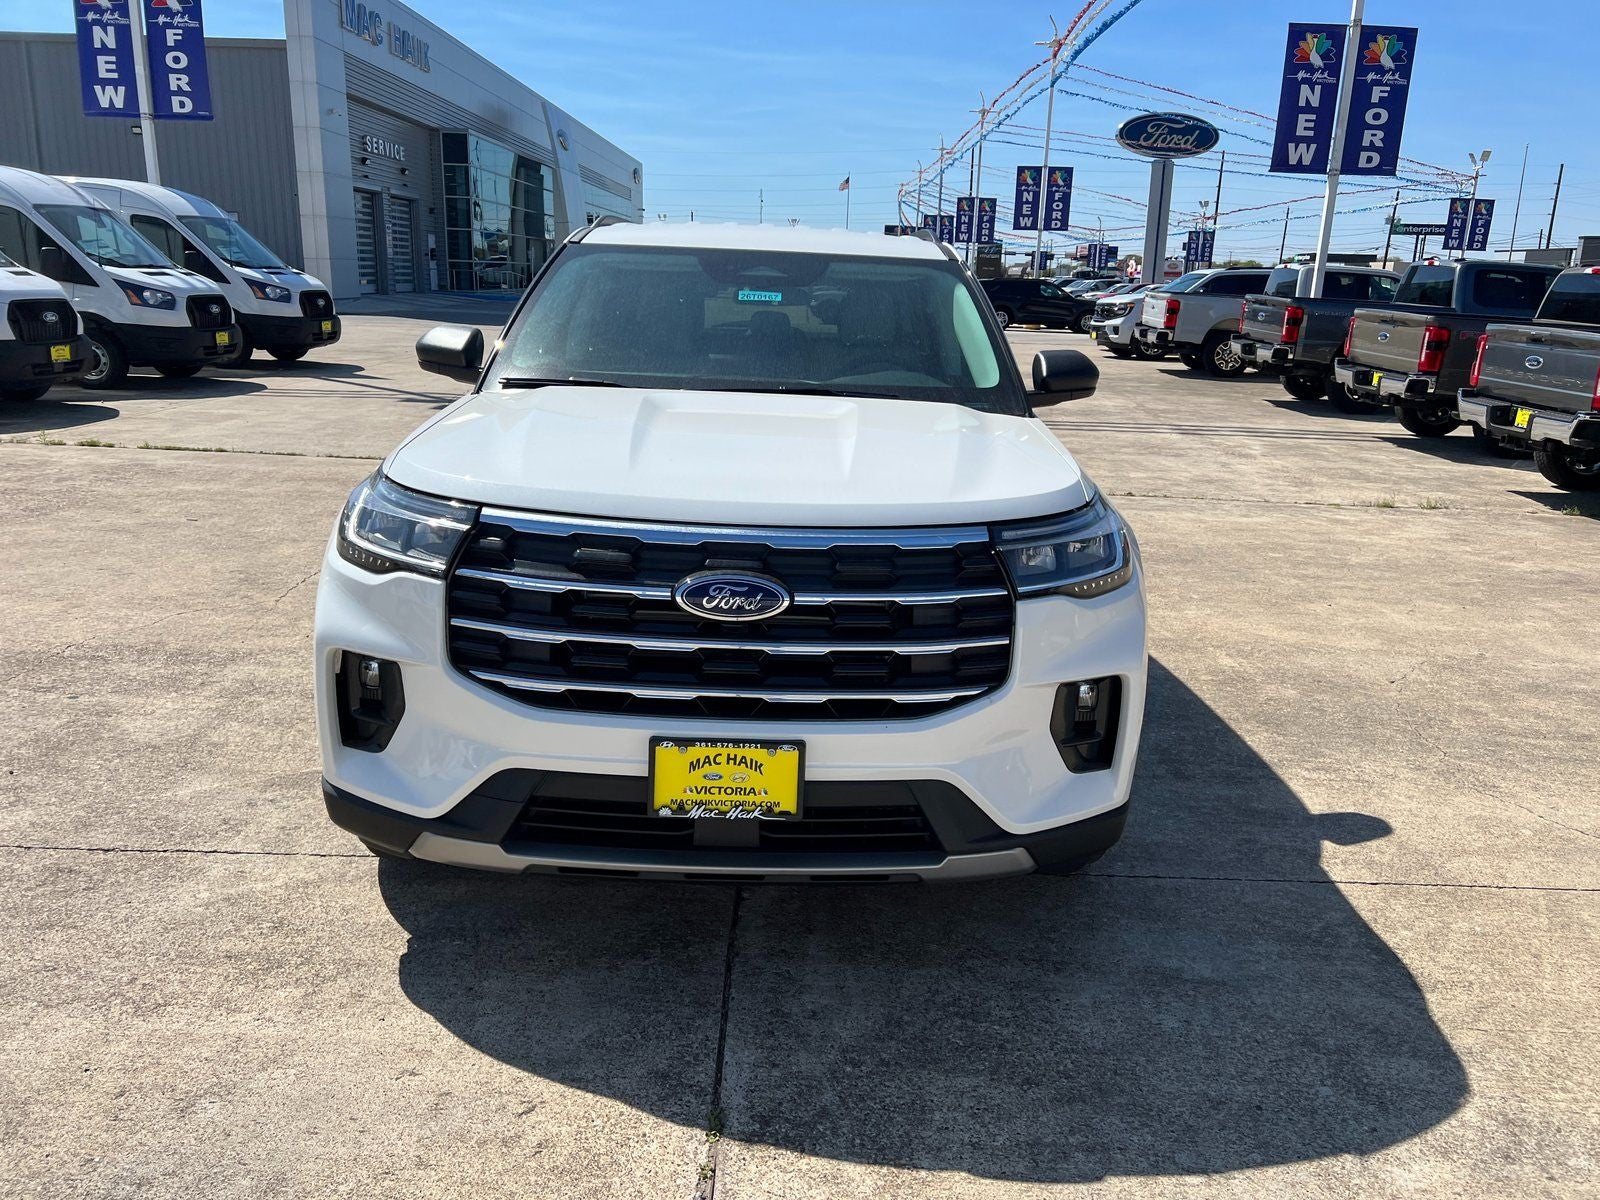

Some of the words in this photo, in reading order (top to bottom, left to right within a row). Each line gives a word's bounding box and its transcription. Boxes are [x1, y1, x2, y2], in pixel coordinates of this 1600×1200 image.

[339, 0, 384, 47] MAC
[388, 22, 431, 73] HAIK
[92, 25, 126, 109] NEW
[165, 28, 194, 114] FORD
[1140, 121, 1200, 147] Ford
[1287, 84, 1321, 166] NEW
[1357, 86, 1391, 169] FORD
[365, 135, 406, 161] SERVICE
[1019, 191, 1034, 227] NEW
[1050, 192, 1063, 229] FORD
[959, 215, 969, 241] NEW
[981, 215, 990, 242] FORD
[1396, 225, 1446, 234] enterprise
[1448, 218, 1462, 248] NEW
[1472, 219, 1485, 249] FORD
[1189, 243, 1197, 261] NEW
[1203, 243, 1211, 262] FORD
[702, 584, 764, 610] Ford
[688, 753, 723, 774] MAC
[725, 753, 764, 776] HAIK
[669, 798, 782, 809] MACHAIKVICTORIA.COM
[694, 785, 758, 797] VICTORIA
[684, 804, 722, 820] Mac
[725, 806, 769, 820] Haik
